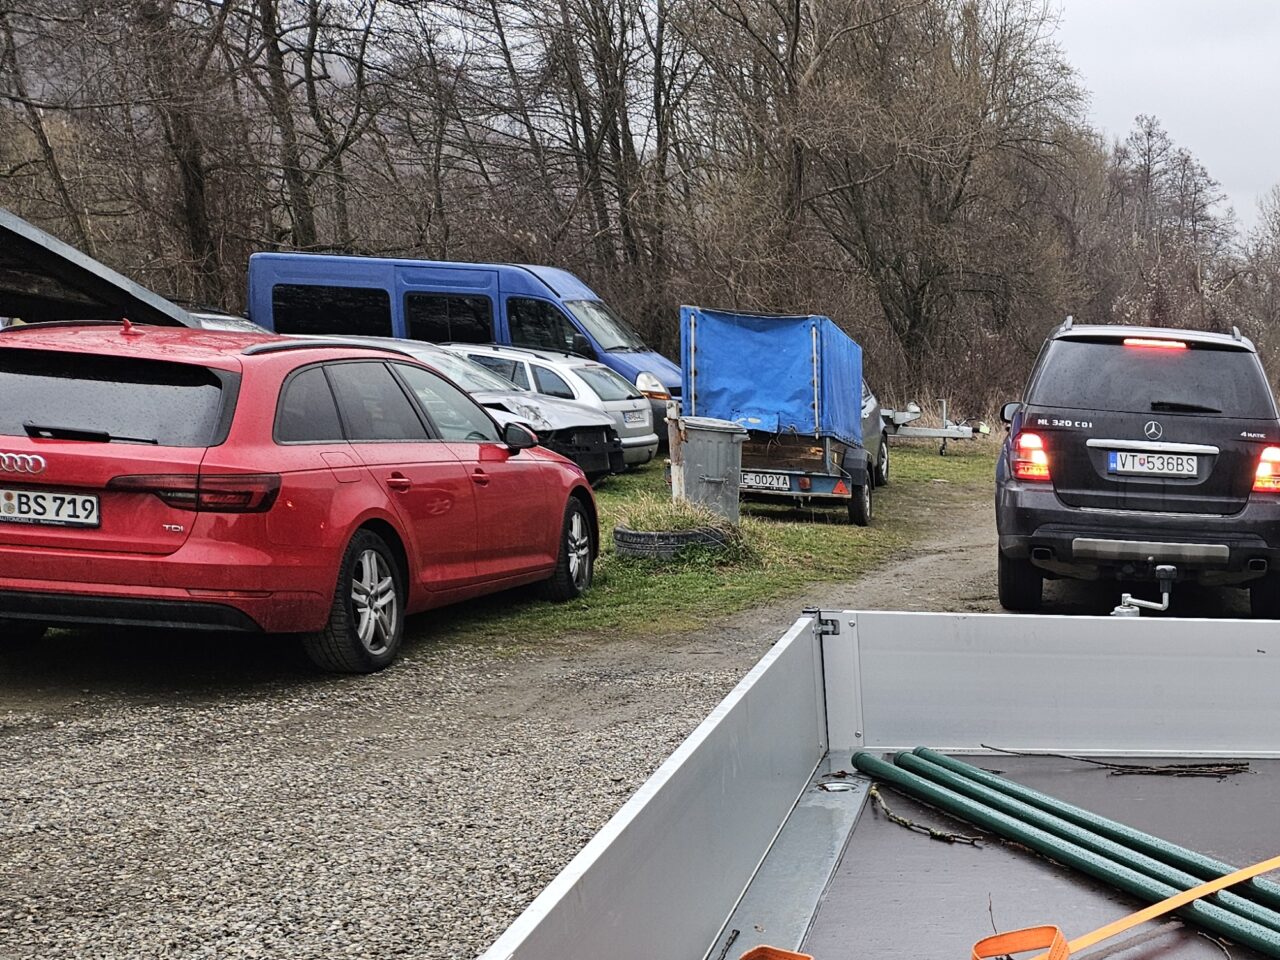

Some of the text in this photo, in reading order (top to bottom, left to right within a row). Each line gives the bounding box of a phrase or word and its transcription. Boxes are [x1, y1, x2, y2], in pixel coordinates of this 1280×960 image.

[1052, 419, 1072, 427] 320
[1119, 453, 1195, 473] VT 536BS
[17, 493, 95, 520] BS 719
[162, 524, 184, 532] TDI
